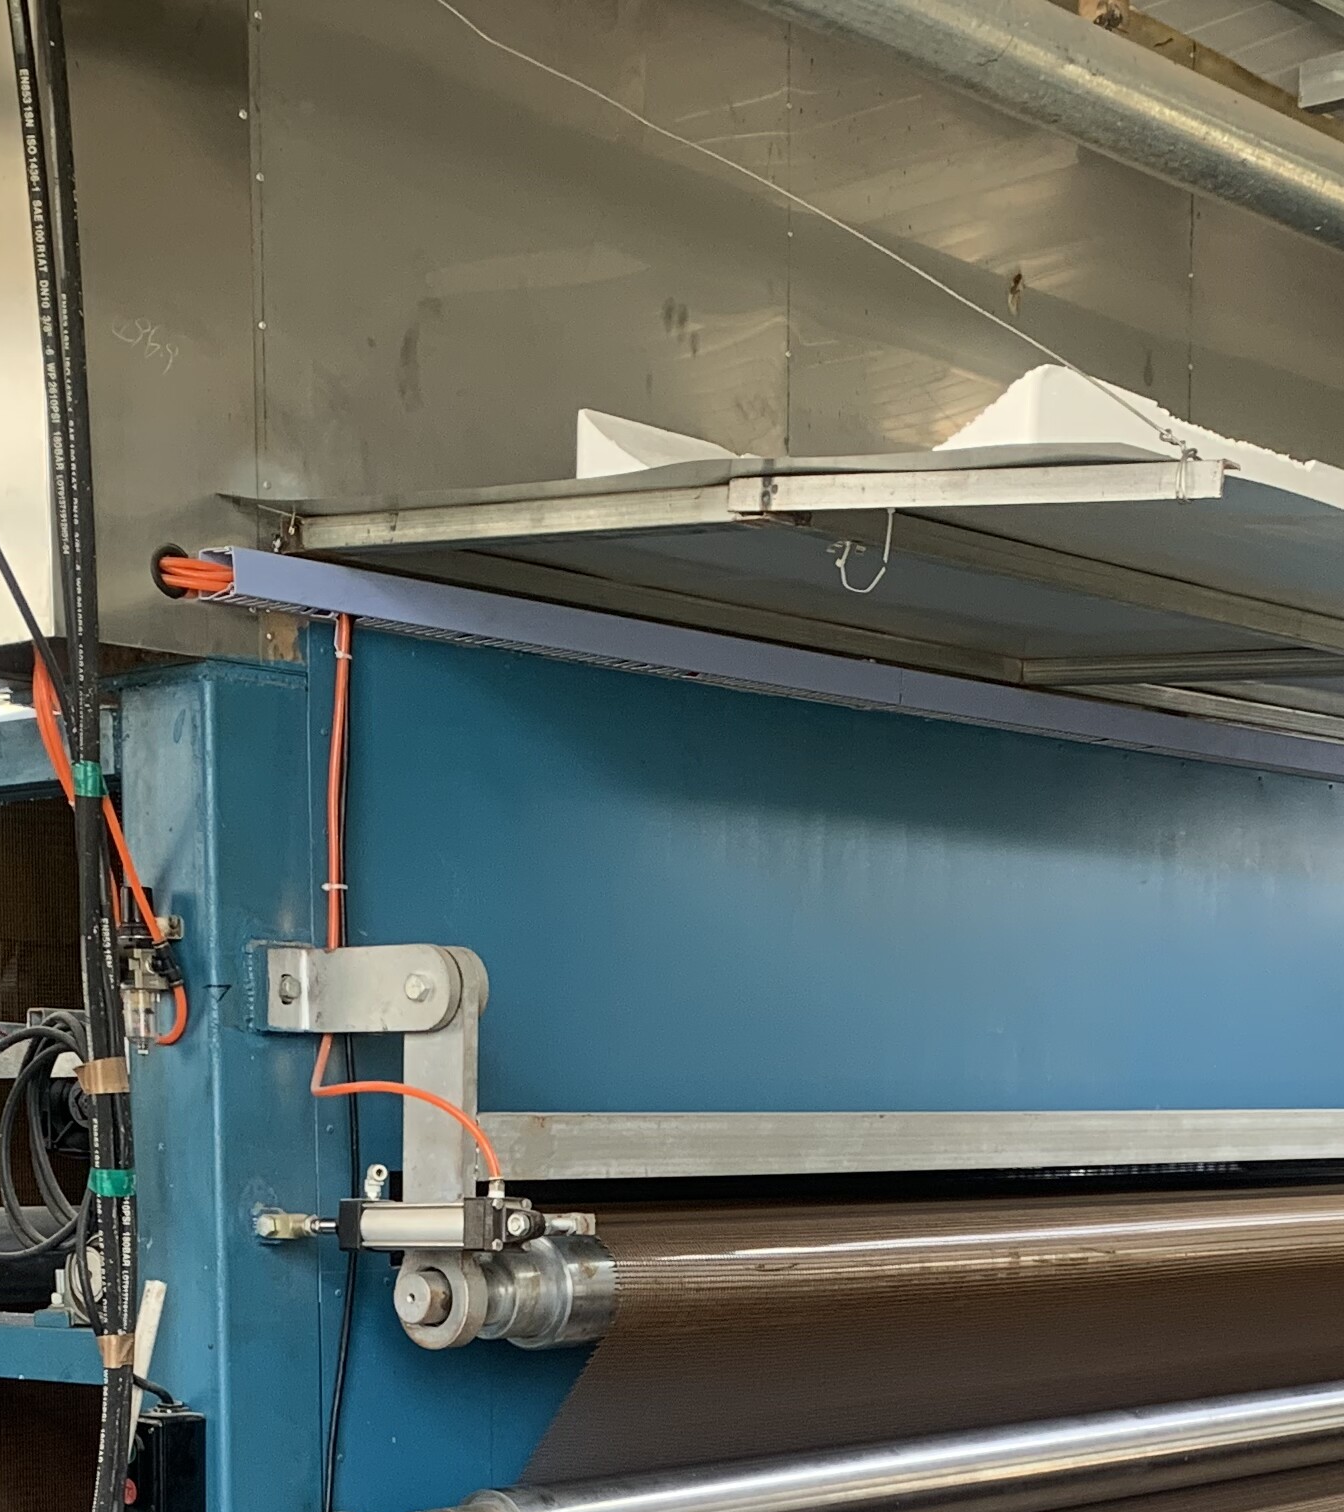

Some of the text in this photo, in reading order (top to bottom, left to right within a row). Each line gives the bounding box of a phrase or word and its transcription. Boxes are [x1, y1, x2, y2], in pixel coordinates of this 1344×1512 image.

[24, 105, 35, 127] 1SN
[26, 134, 37, 155] ISO
[32, 199, 44, 222] SAE
[35, 224, 45, 243] 100
[36, 244, 48, 272] R1AT
[39, 279, 50, 308] DN10
[46, 362, 56, 380] WP
[48, 381, 61, 424] 2610PSI
[53, 431, 65, 470] 180BAR
